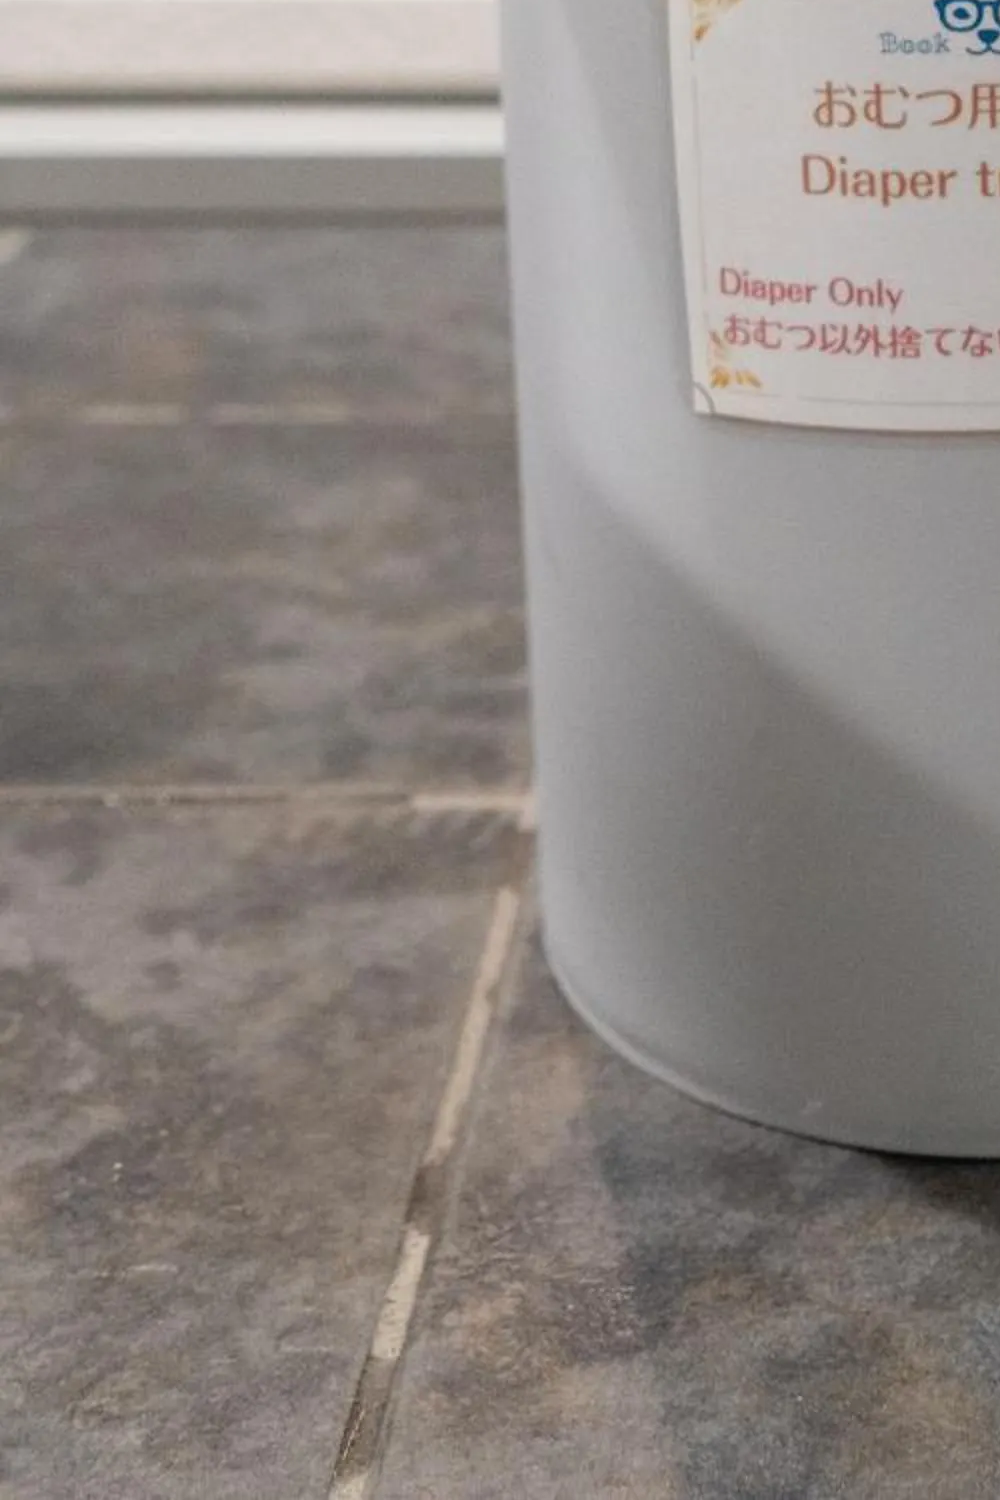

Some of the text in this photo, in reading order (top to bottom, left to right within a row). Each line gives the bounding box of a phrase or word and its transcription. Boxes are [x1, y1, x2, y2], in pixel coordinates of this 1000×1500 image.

[880, 32, 950, 54] Book
[801, 153, 957, 206] Diaper
[719, 267, 904, 313] Diaper Only
